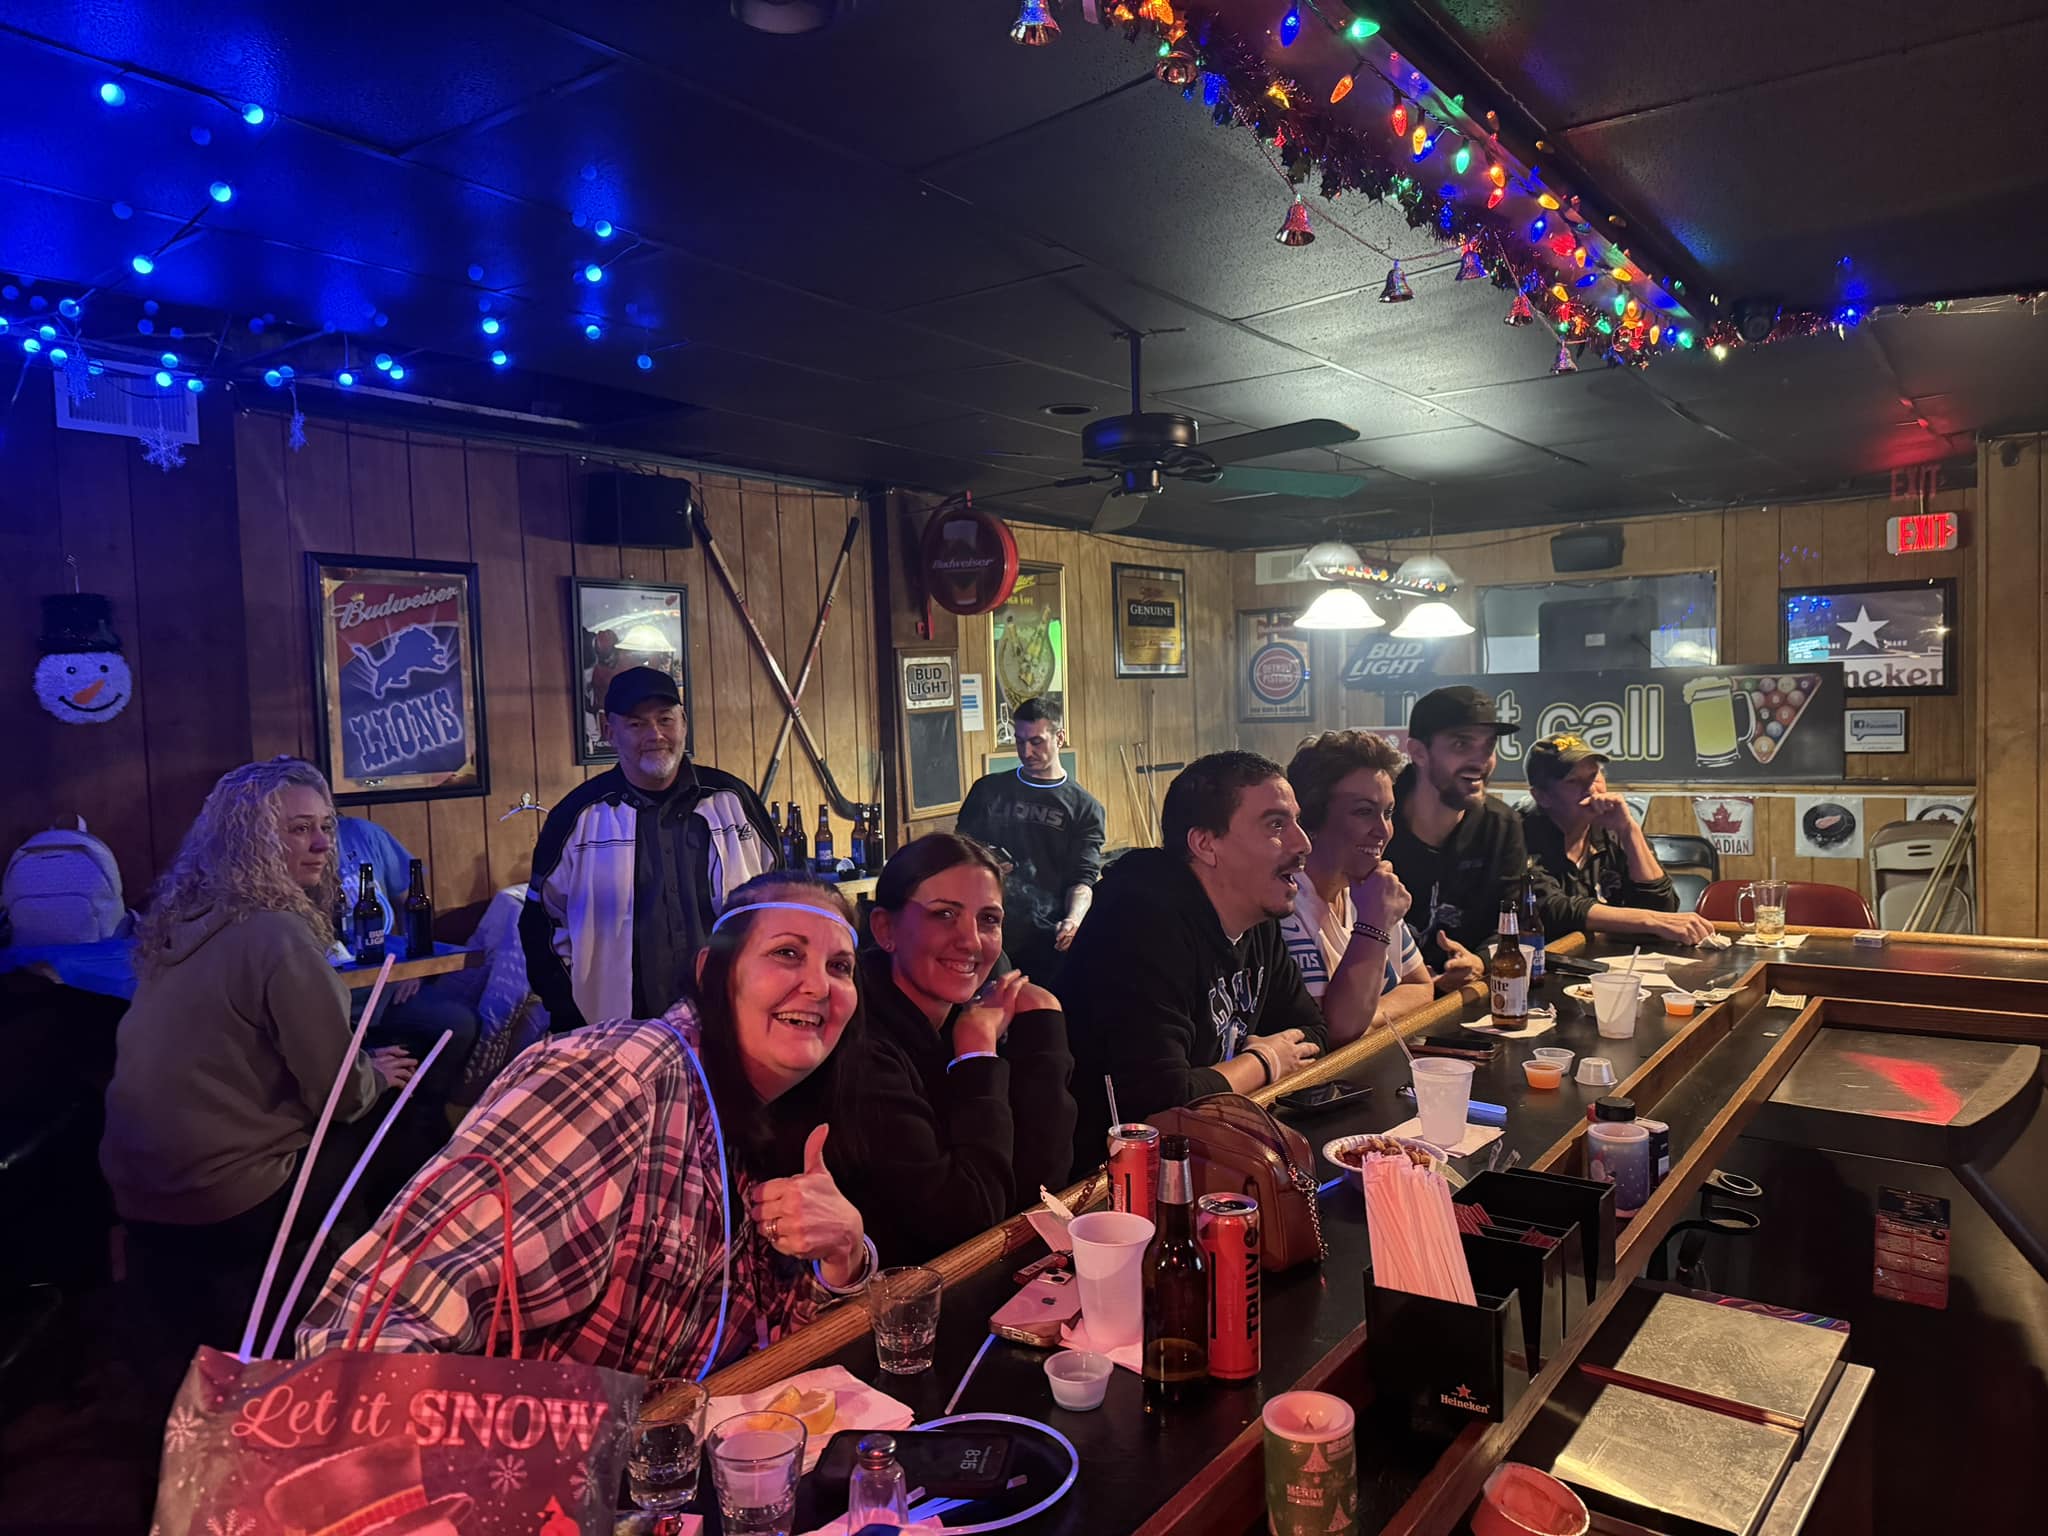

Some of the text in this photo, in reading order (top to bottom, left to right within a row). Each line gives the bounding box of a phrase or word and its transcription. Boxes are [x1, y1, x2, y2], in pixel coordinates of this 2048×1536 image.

[1898, 513, 1950, 551] EXIT
[332, 585, 460, 630] Budweiser
[1130, 604, 1173, 617] GENUINE
[1366, 642, 1424, 660] BUD
[915, 667, 942, 681] BUD
[1349, 658, 1425, 677] LIGHT
[910, 680, 948, 695] LIGHT
[350, 687, 464, 772] LIONS
[1537, 684, 1664, 762] call
[1440, 1393, 1488, 1414] Heineken
[230, 1385, 609, 1453] Let it SNOW
[960, 1449, 982, 1470] 8:15
